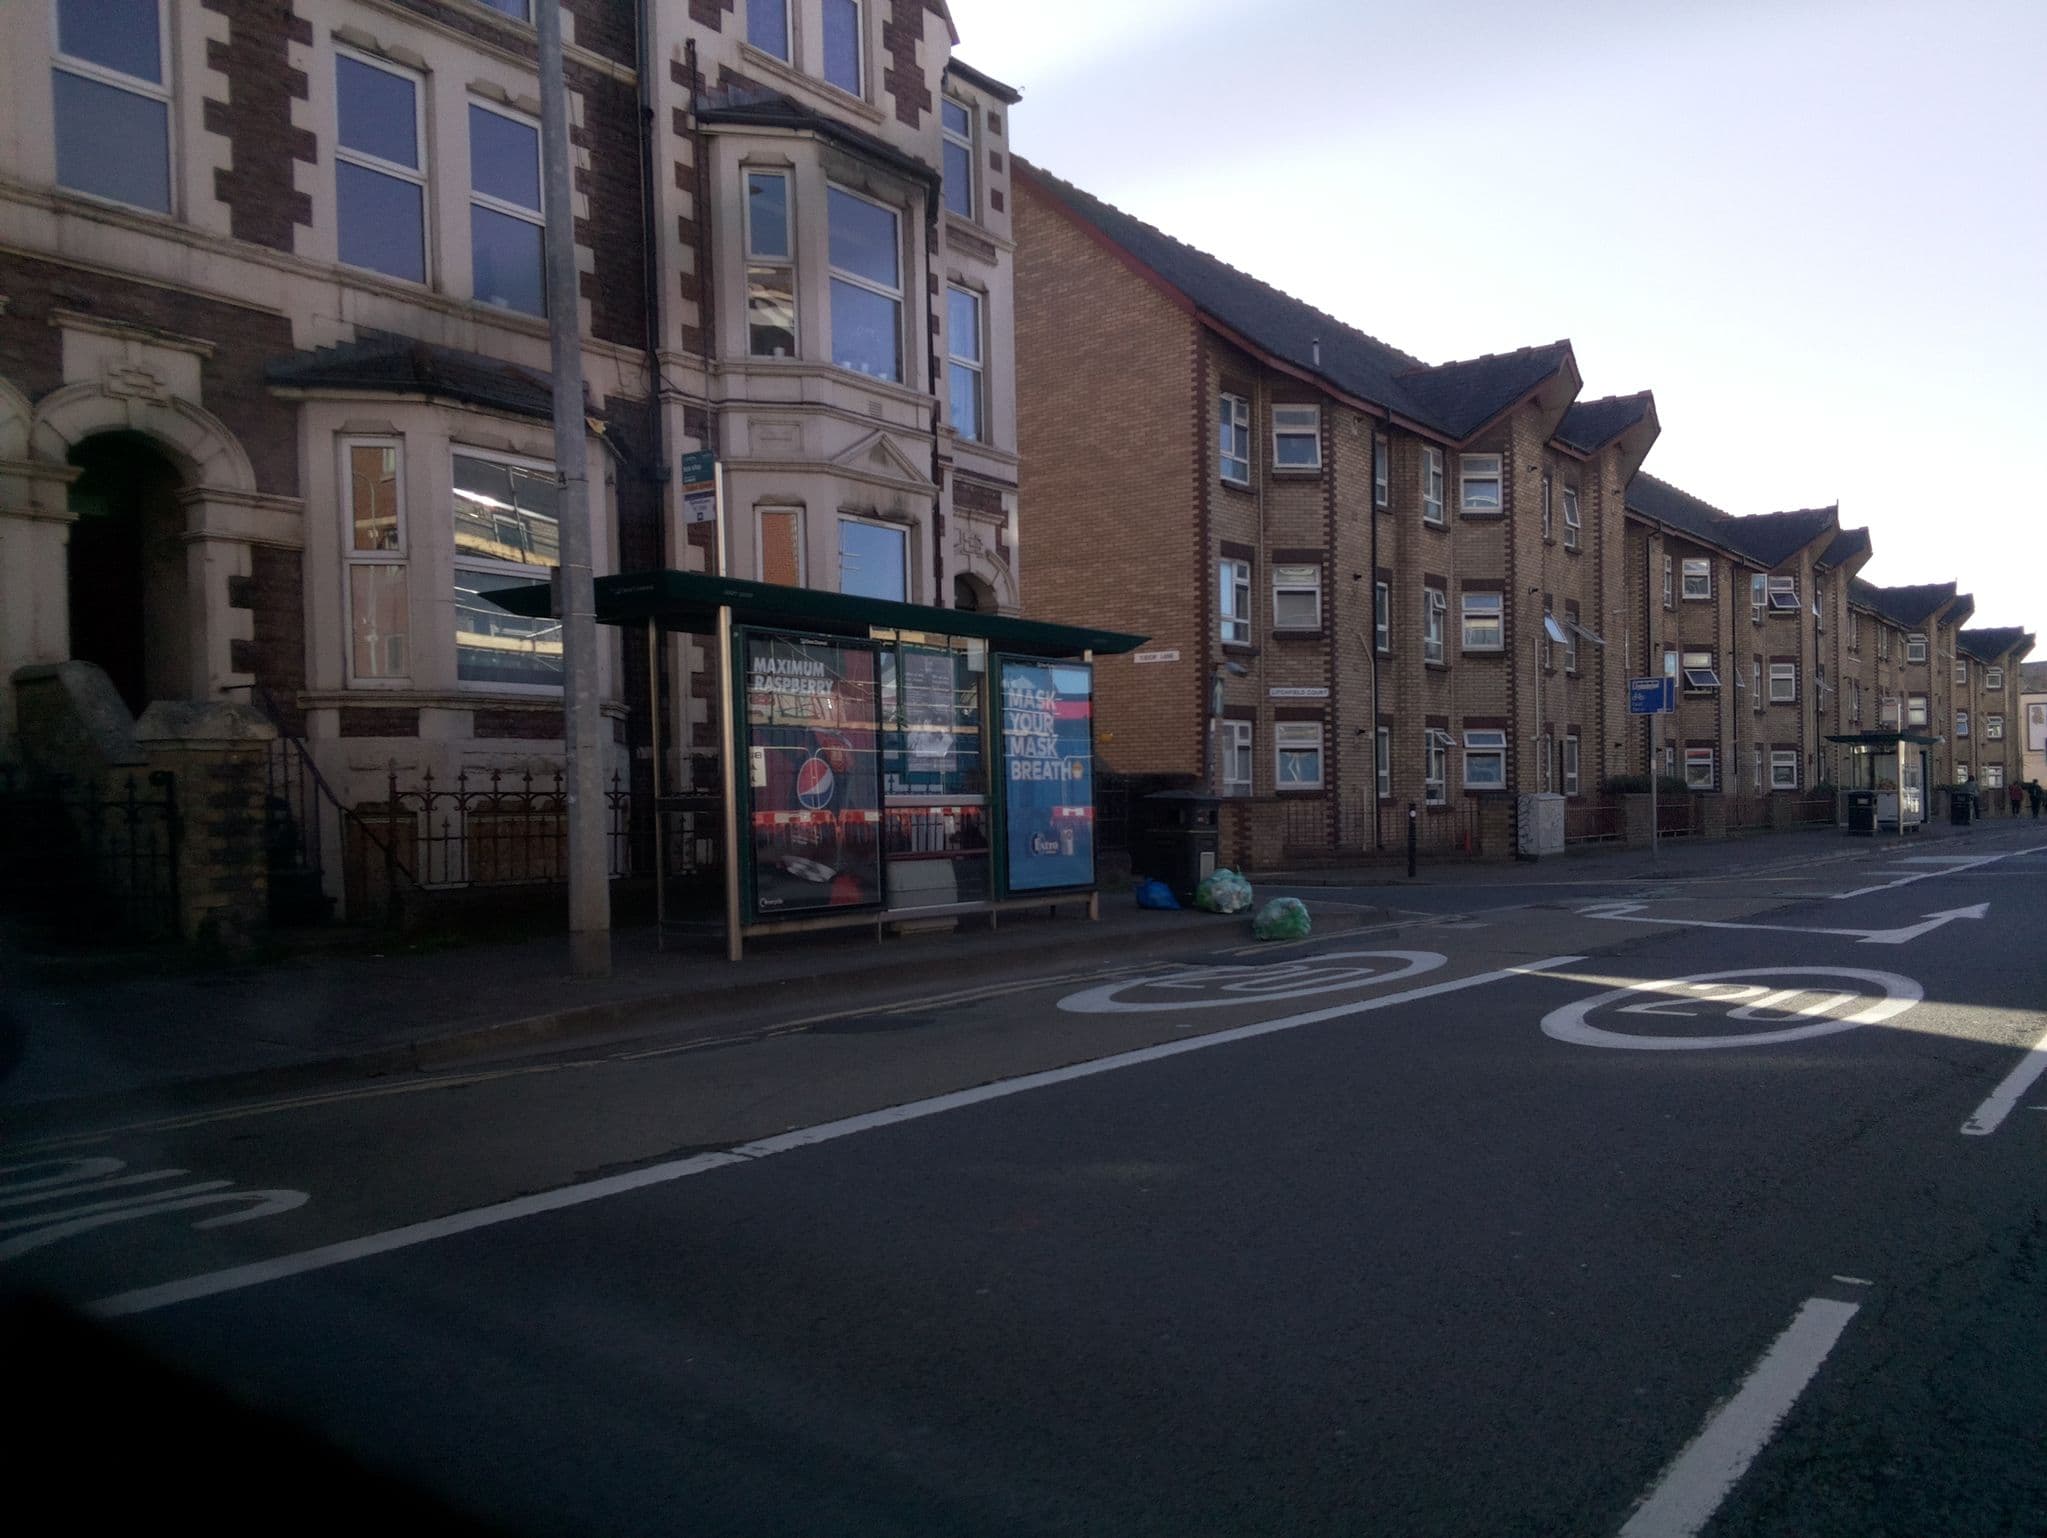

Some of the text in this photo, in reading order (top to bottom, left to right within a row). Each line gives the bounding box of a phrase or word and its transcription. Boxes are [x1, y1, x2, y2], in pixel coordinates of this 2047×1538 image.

[753, 656, 825, 678] MAXIMUM
[753, 676, 835, 695] RASPBERRY
[1008, 687, 1057, 710] MASK
[1008, 711, 1055, 734] YOUR
[1009, 735, 1058, 757] MASK
[1011, 760, 1073, 781] BREATH
[1614, 983, 1862, 1022] 20
